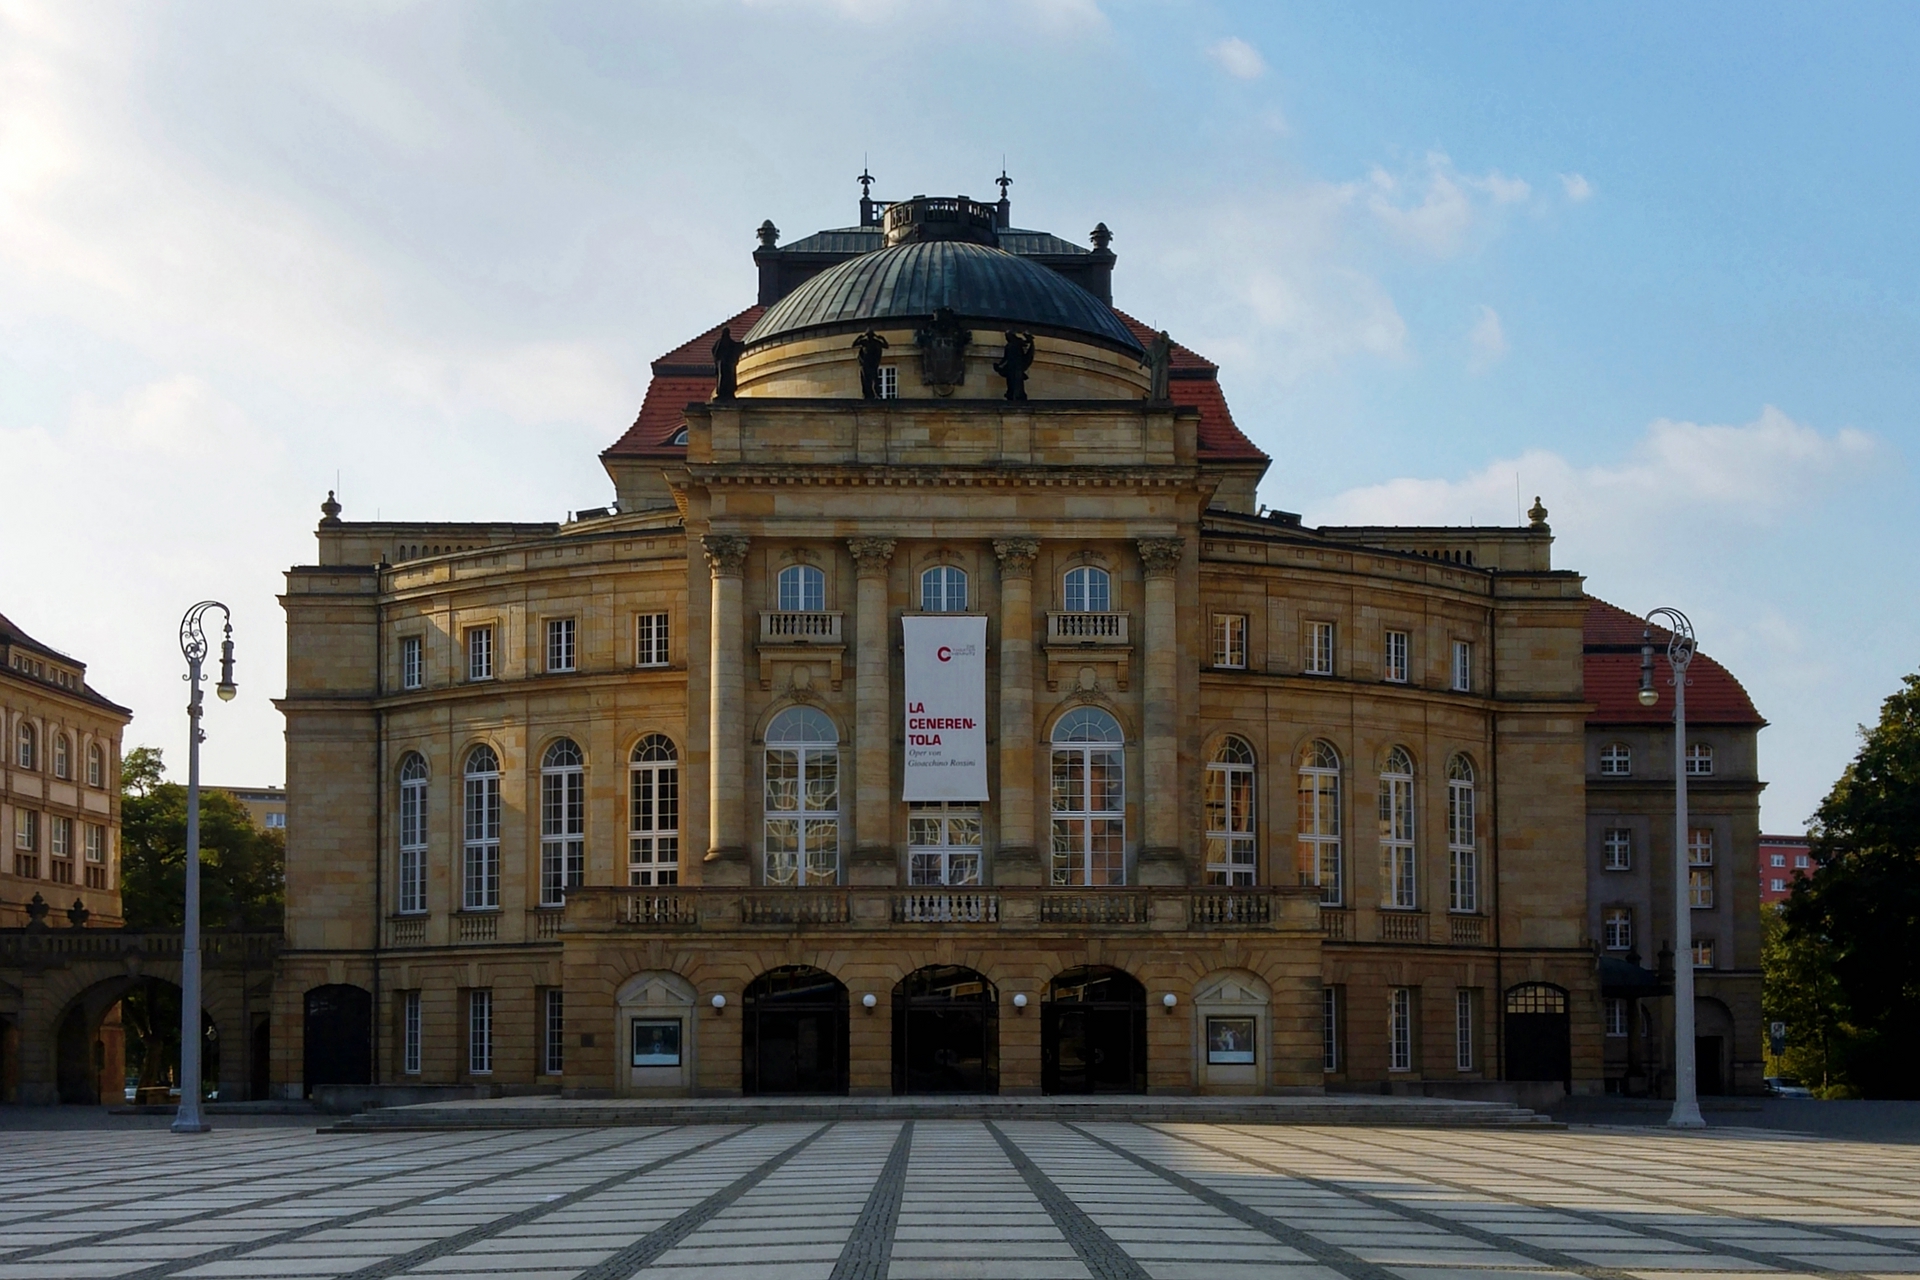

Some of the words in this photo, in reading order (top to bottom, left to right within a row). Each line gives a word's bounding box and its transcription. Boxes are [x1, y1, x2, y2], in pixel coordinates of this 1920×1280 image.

[909, 702, 925, 714] LA
[909, 718, 977, 730] CENEREN-
[908, 734, 942, 746] TOLA
[909, 749, 927, 758] Oper
[908, 759, 949, 768] Gioacchino
[949, 759, 976, 767] Rossini
